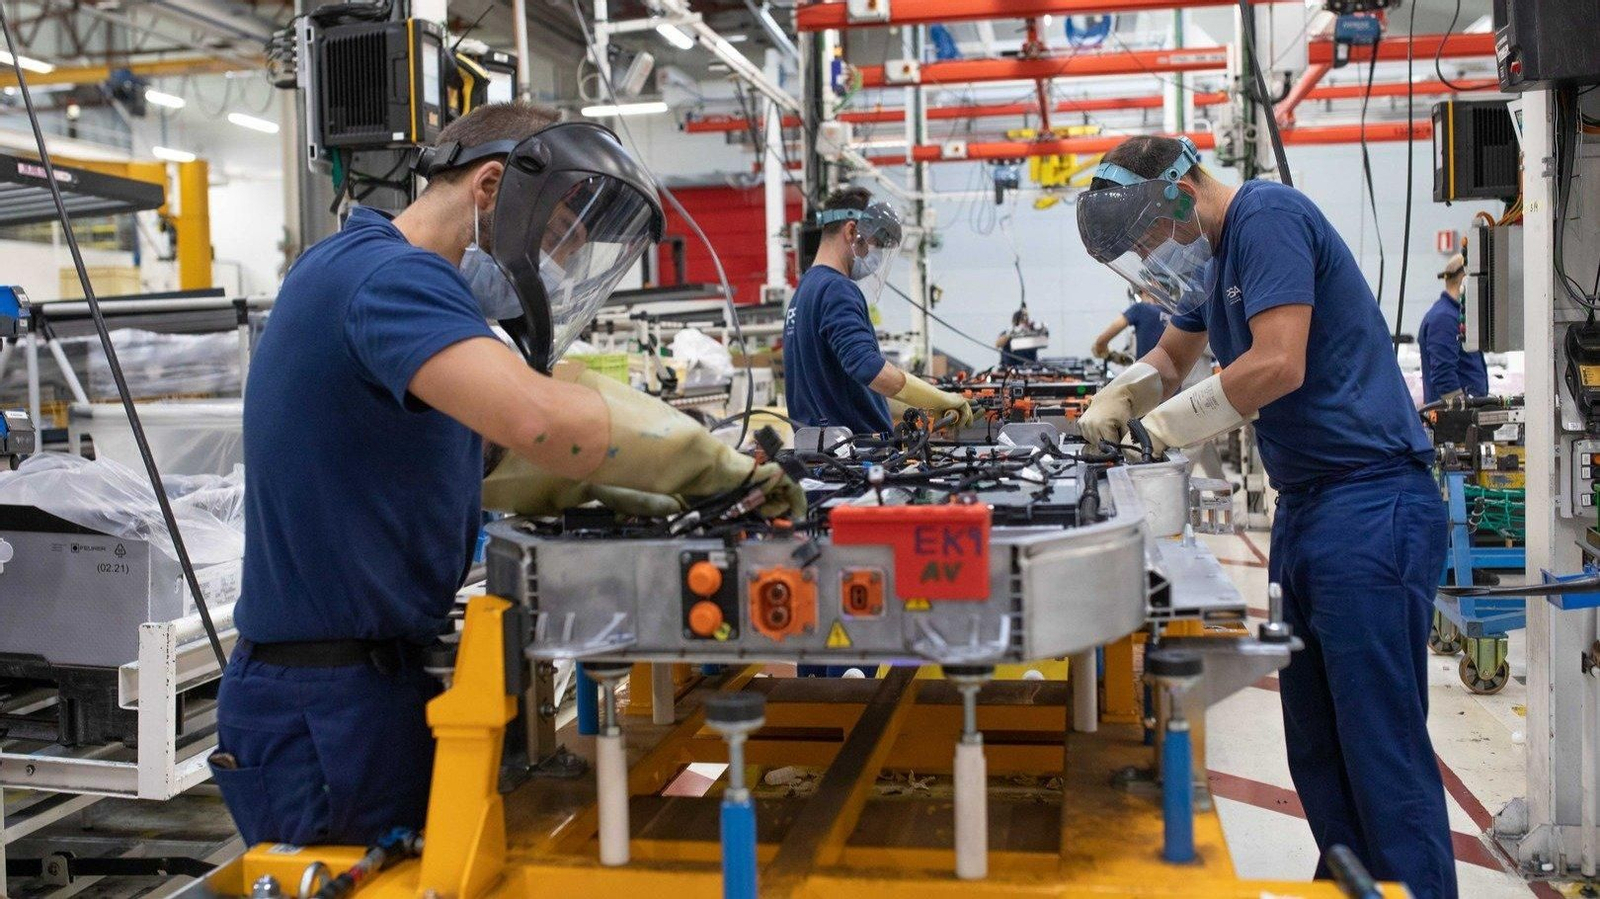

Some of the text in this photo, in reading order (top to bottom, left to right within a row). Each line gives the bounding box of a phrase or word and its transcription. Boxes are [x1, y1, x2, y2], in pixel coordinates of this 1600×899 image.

[914, 525, 982, 555] EK1
[97, 563, 129, 574] (02.21)
[921, 561, 963, 583] AV
